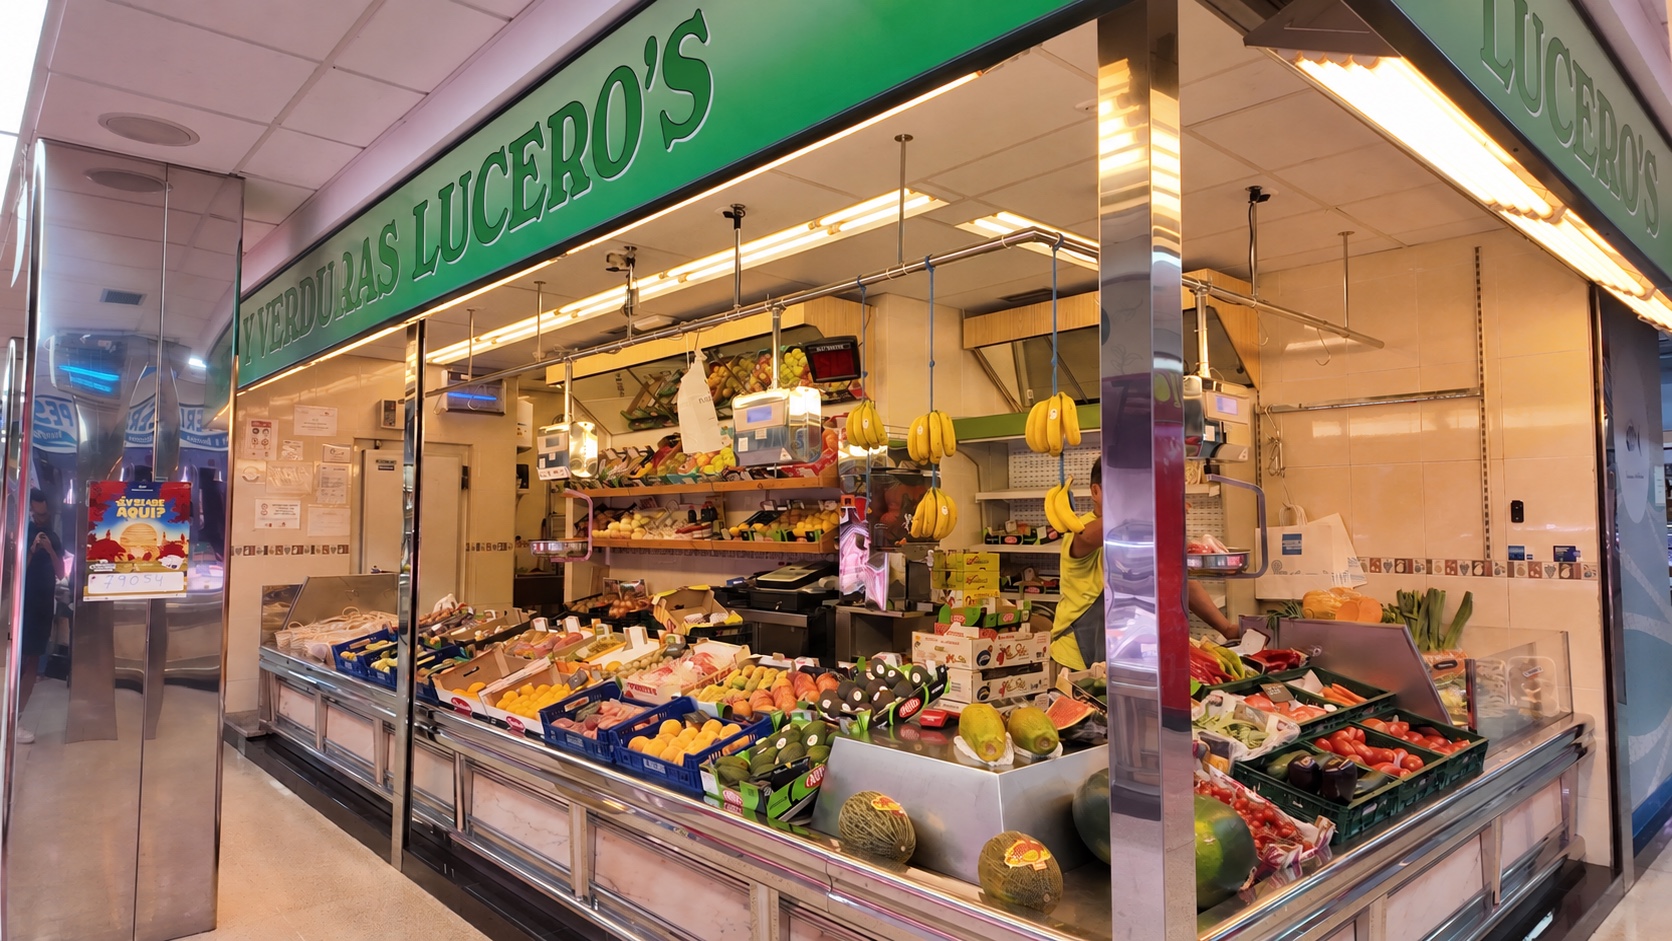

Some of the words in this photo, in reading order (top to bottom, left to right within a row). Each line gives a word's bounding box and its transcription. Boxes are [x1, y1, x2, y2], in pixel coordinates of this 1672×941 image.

[243, 313, 255, 366] Y
[258, 219, 400, 358] VERDURAS
[412, 8, 714, 283] LUCERO'S
[1480, 0, 1660, 239] LUCERO'S
[103, 574, 164, 590] 79054
